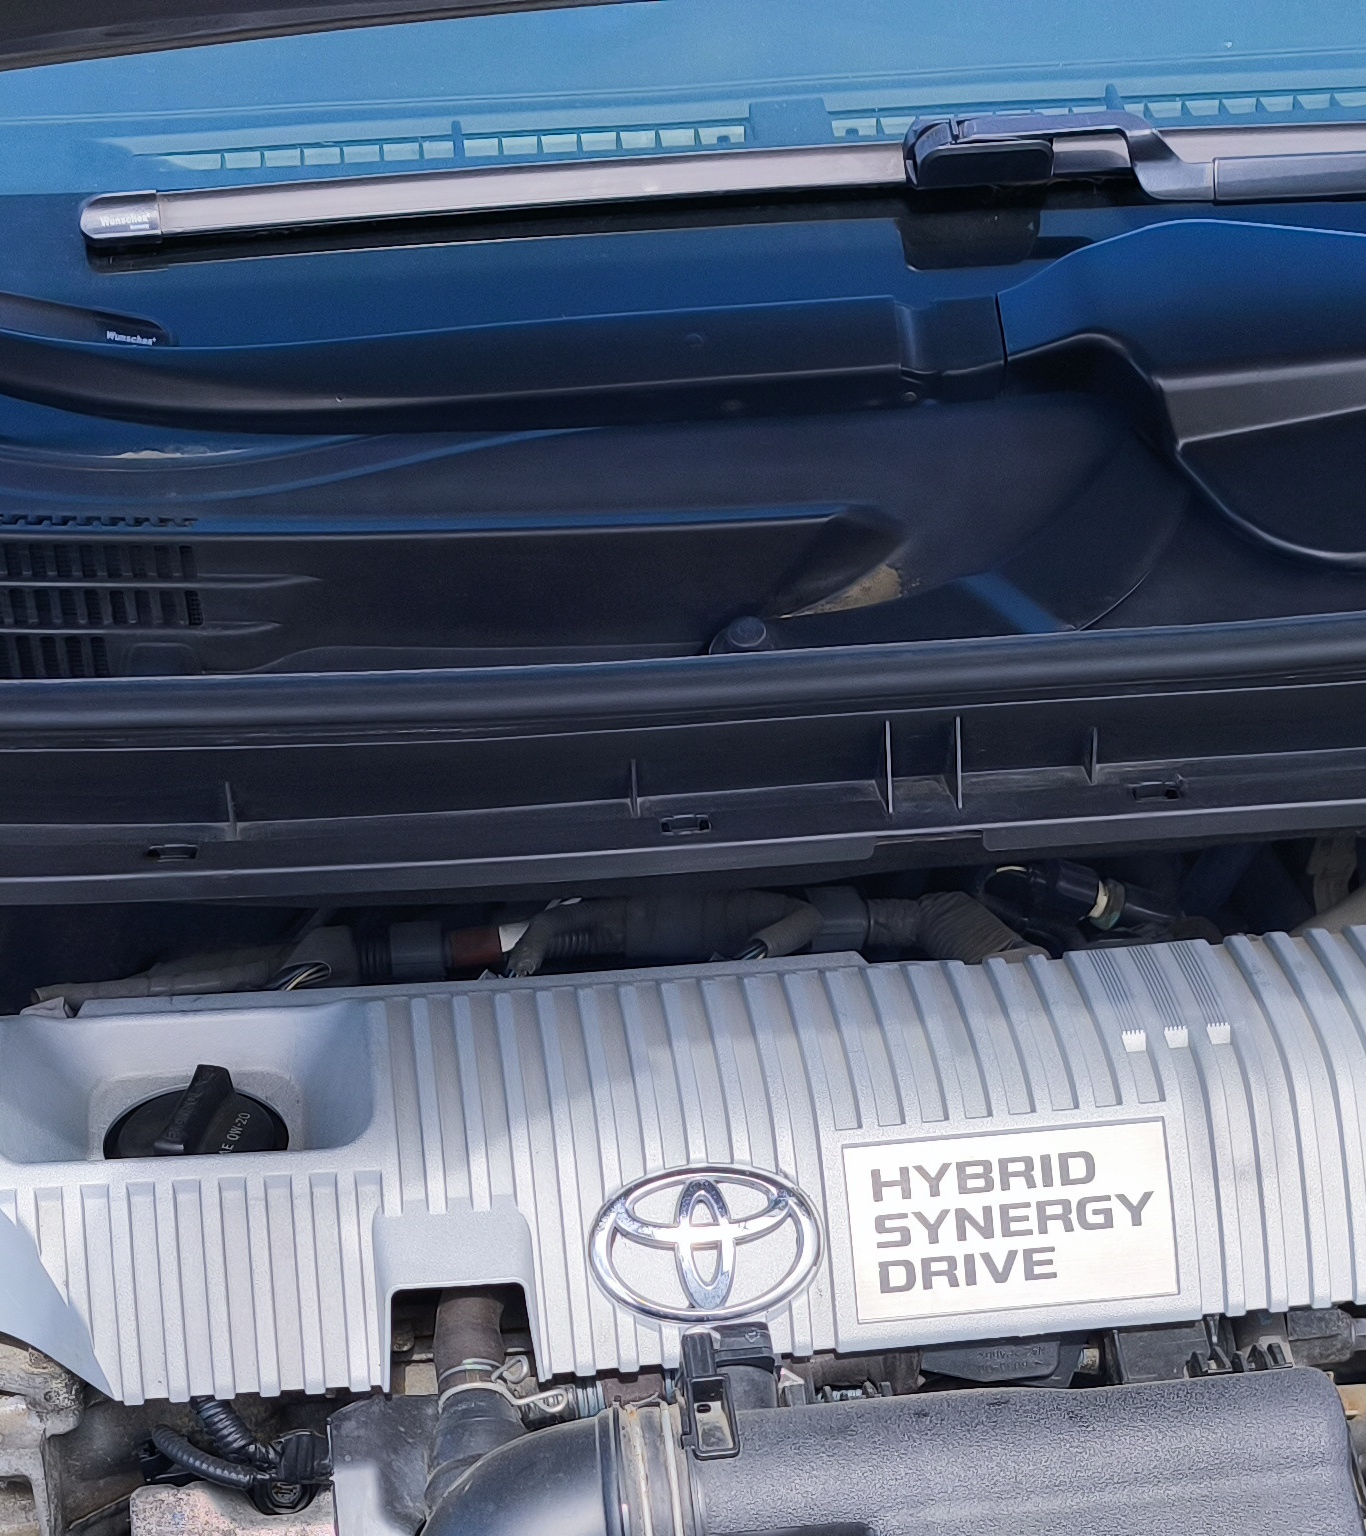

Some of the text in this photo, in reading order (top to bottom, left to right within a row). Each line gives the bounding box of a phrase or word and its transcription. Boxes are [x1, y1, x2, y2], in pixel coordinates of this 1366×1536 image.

[870, 1150, 1097, 1202] HYBRID
[874, 1191, 1155, 1249] SYNERGY
[877, 1246, 1059, 1295] DRIVE
